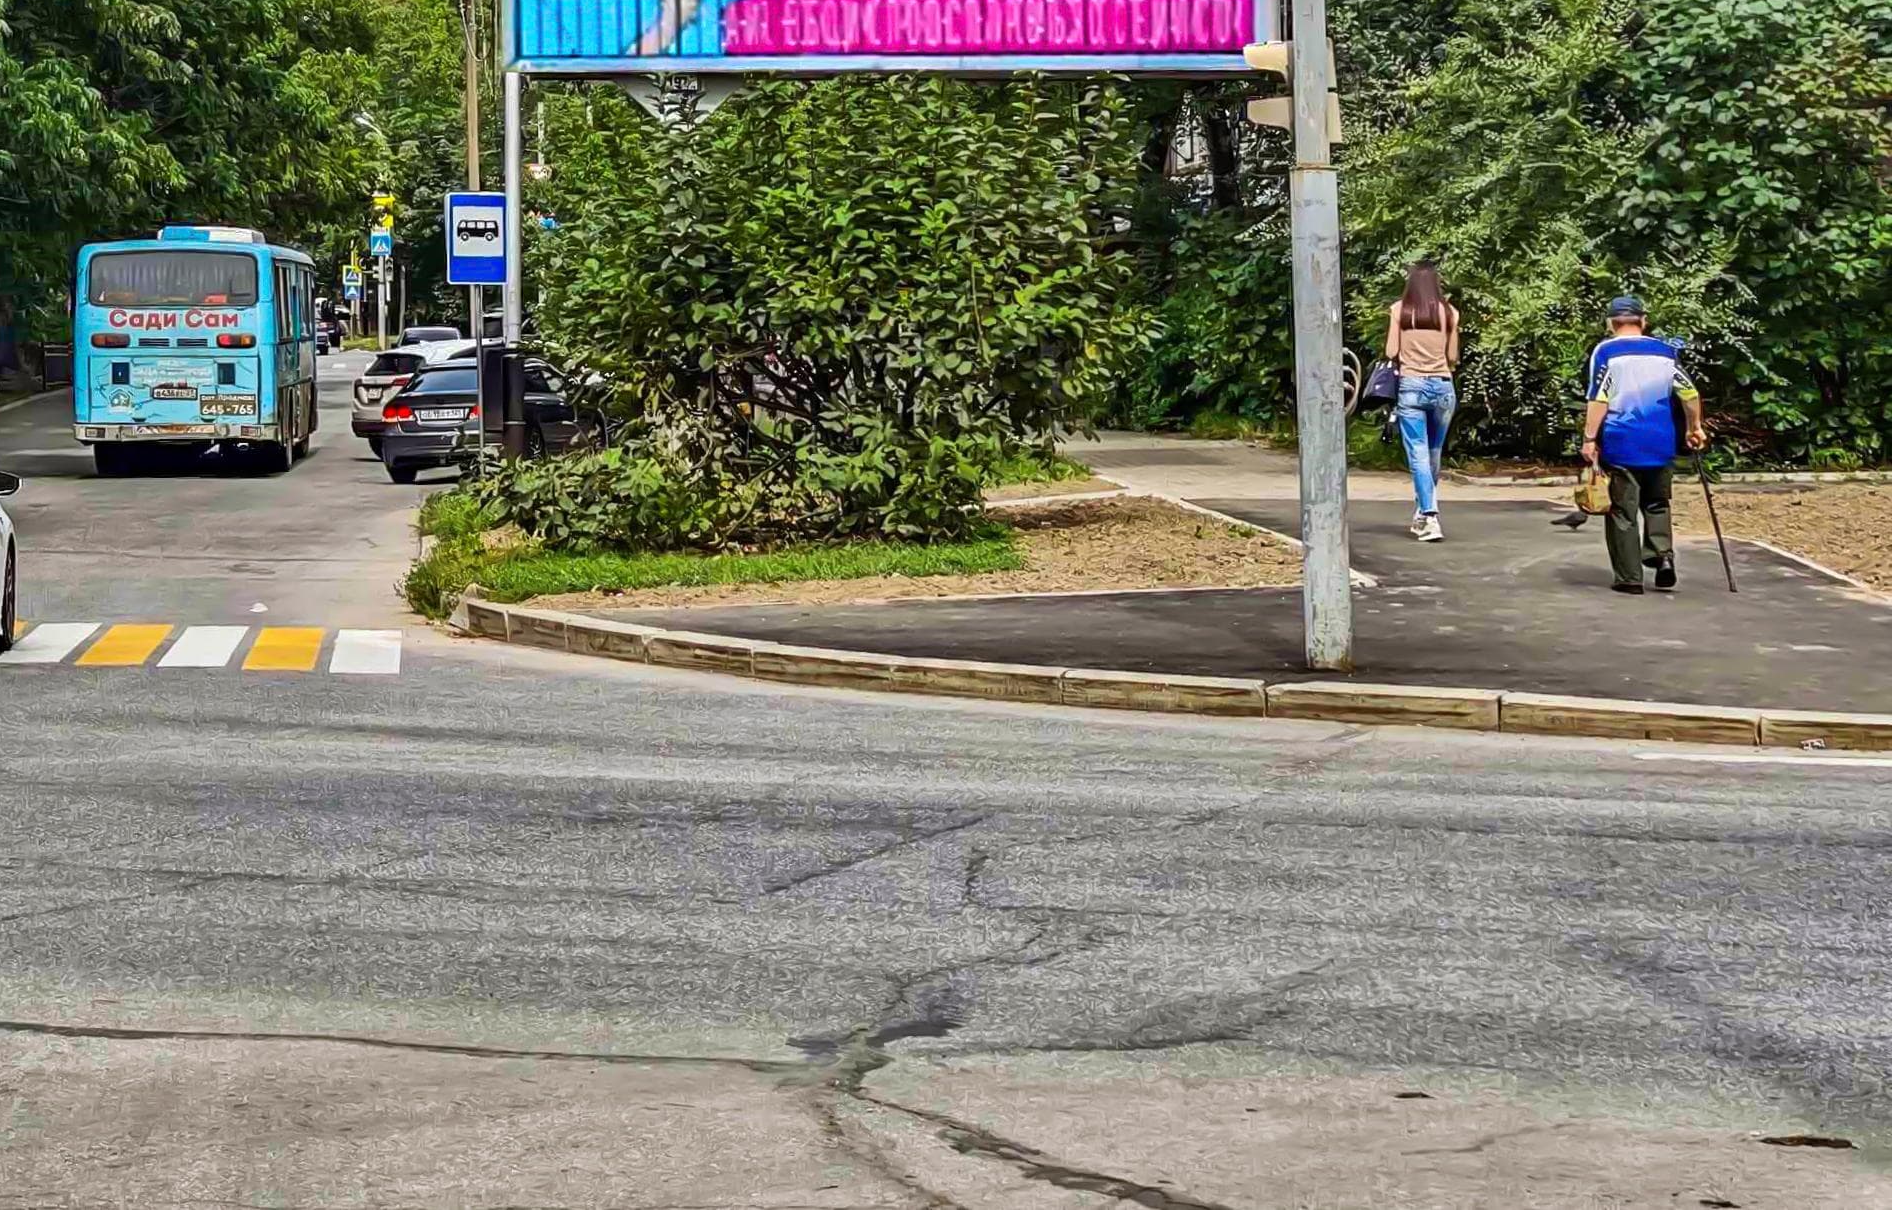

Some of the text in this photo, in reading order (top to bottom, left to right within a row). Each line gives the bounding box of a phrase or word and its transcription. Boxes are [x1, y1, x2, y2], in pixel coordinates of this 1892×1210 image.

[109, 308, 239, 330] Сади Сам
[202, 404, 254, 415] 645-765
